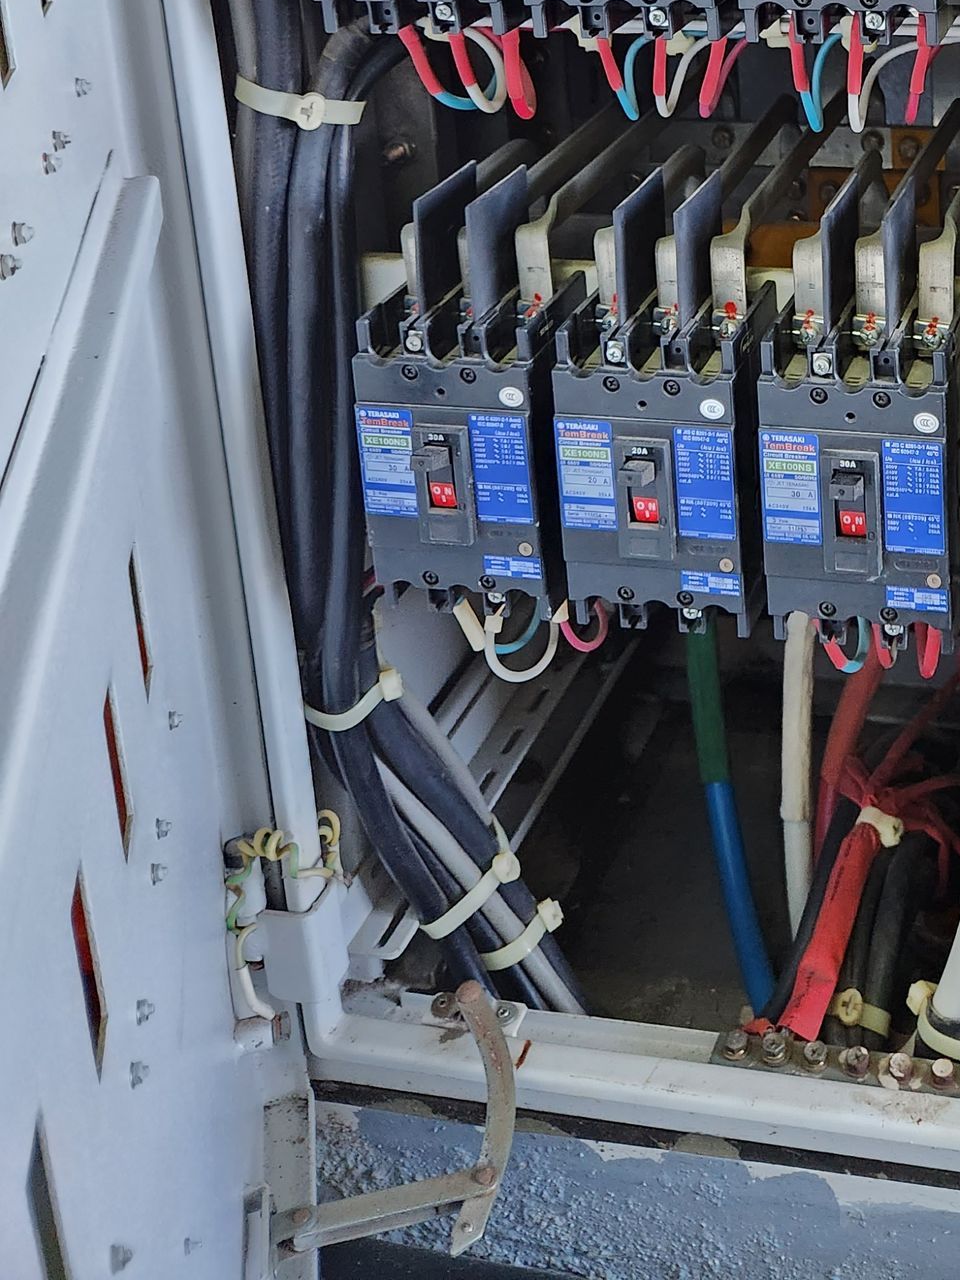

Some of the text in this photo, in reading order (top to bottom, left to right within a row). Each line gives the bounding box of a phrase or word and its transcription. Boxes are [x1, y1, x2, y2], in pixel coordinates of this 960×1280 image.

[361, 418, 408, 427] TemBreak
[559, 430, 608, 439] TemBreak
[771, 435, 804, 443] TERASAKI
[366, 437, 407, 446] XE100NS
[764, 443, 815, 452] TemBreak
[564, 449, 606, 458] XE100NS
[768, 462, 812, 471] XE100NS
